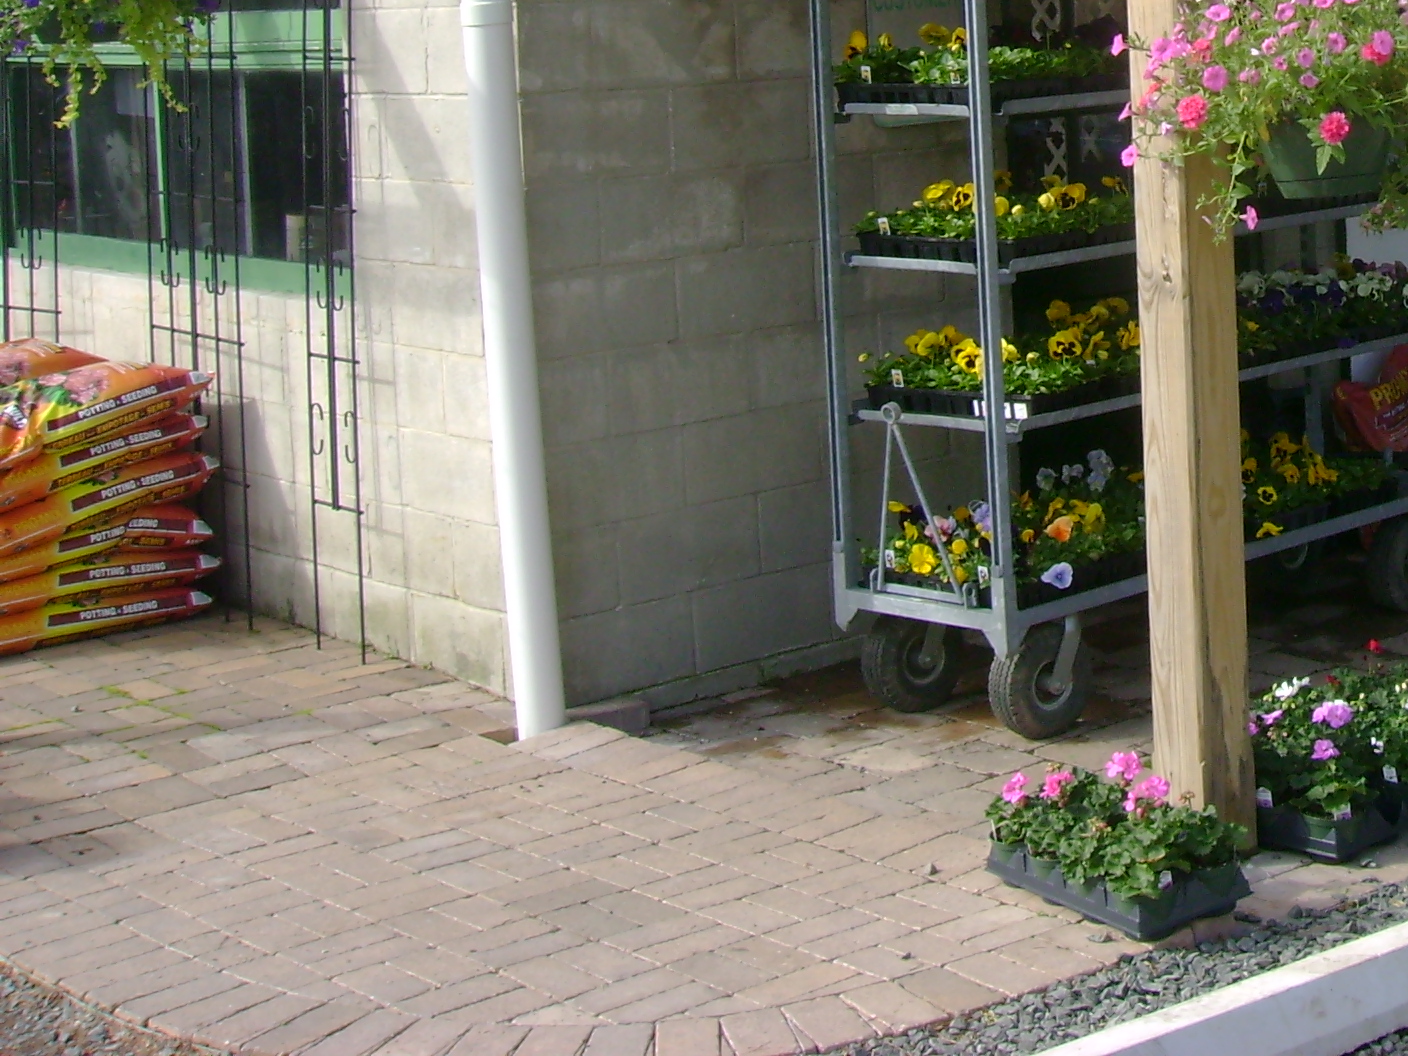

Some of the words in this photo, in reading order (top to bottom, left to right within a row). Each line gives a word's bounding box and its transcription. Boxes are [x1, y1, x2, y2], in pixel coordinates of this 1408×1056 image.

[78, 399, 117, 419] POTTING
[122, 385, 158, 404] SEEDING
[89, 437, 126, 456] POTTING
[128, 429, 163, 445] SEEDING
[101, 479, 137, 499] POTTING
[140, 469, 175, 486] SEEDING
[90, 525, 126, 543] POTTING
[89, 566, 126, 579] POTTING
[130, 561, 166, 574] SEEDING
[80, 606, 117, 620] POTTING
[122, 600, 159, 614] SEEDING
